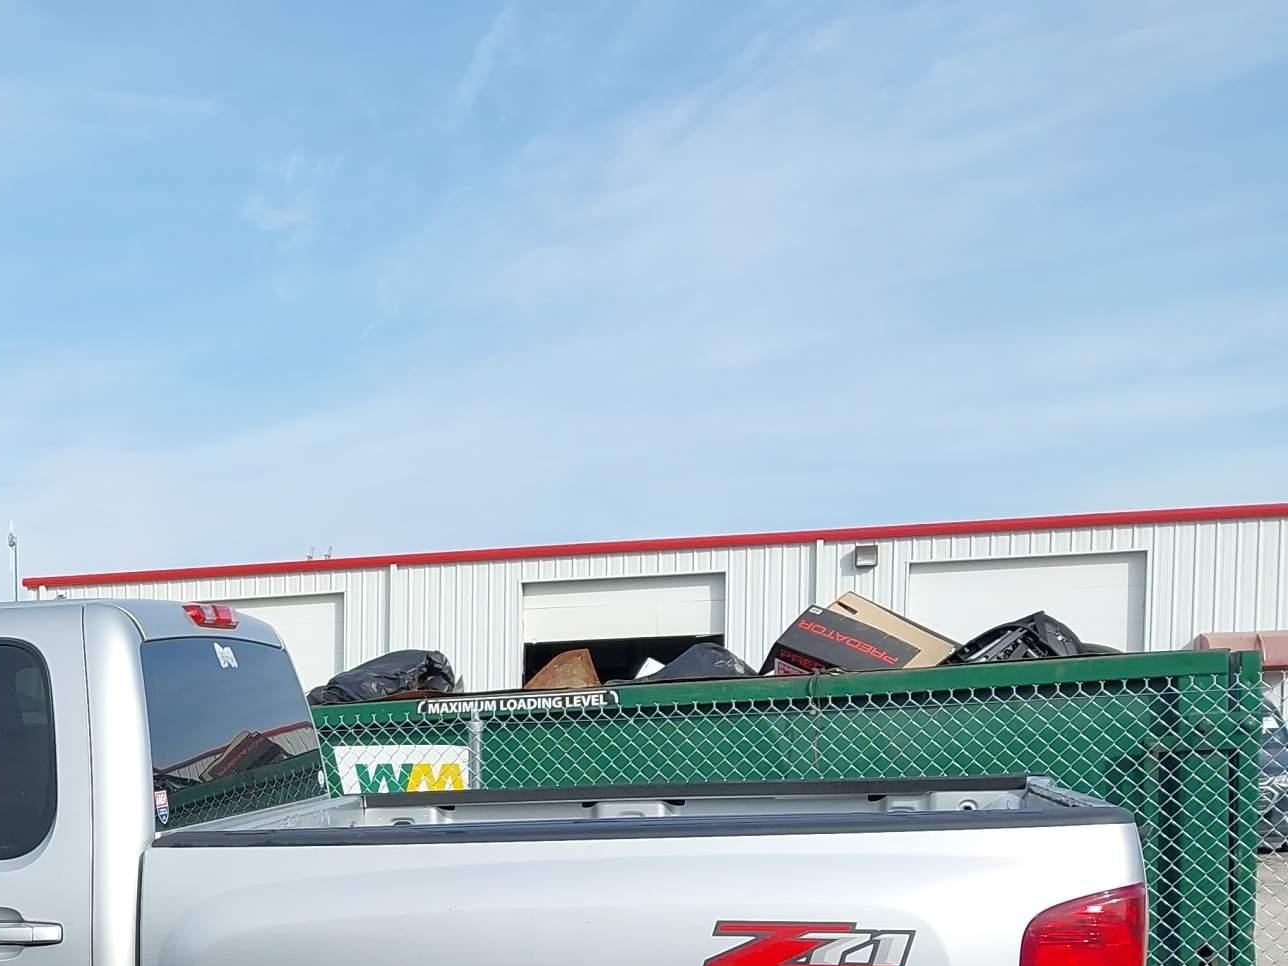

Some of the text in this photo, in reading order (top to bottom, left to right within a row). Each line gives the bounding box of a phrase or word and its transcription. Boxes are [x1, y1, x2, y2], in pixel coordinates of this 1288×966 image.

[798, 619, 899, 666] PREDATOR
[427, 694, 607, 715] MAXIMUM LOADING LEVEL
[355, 763, 464, 793] WM
